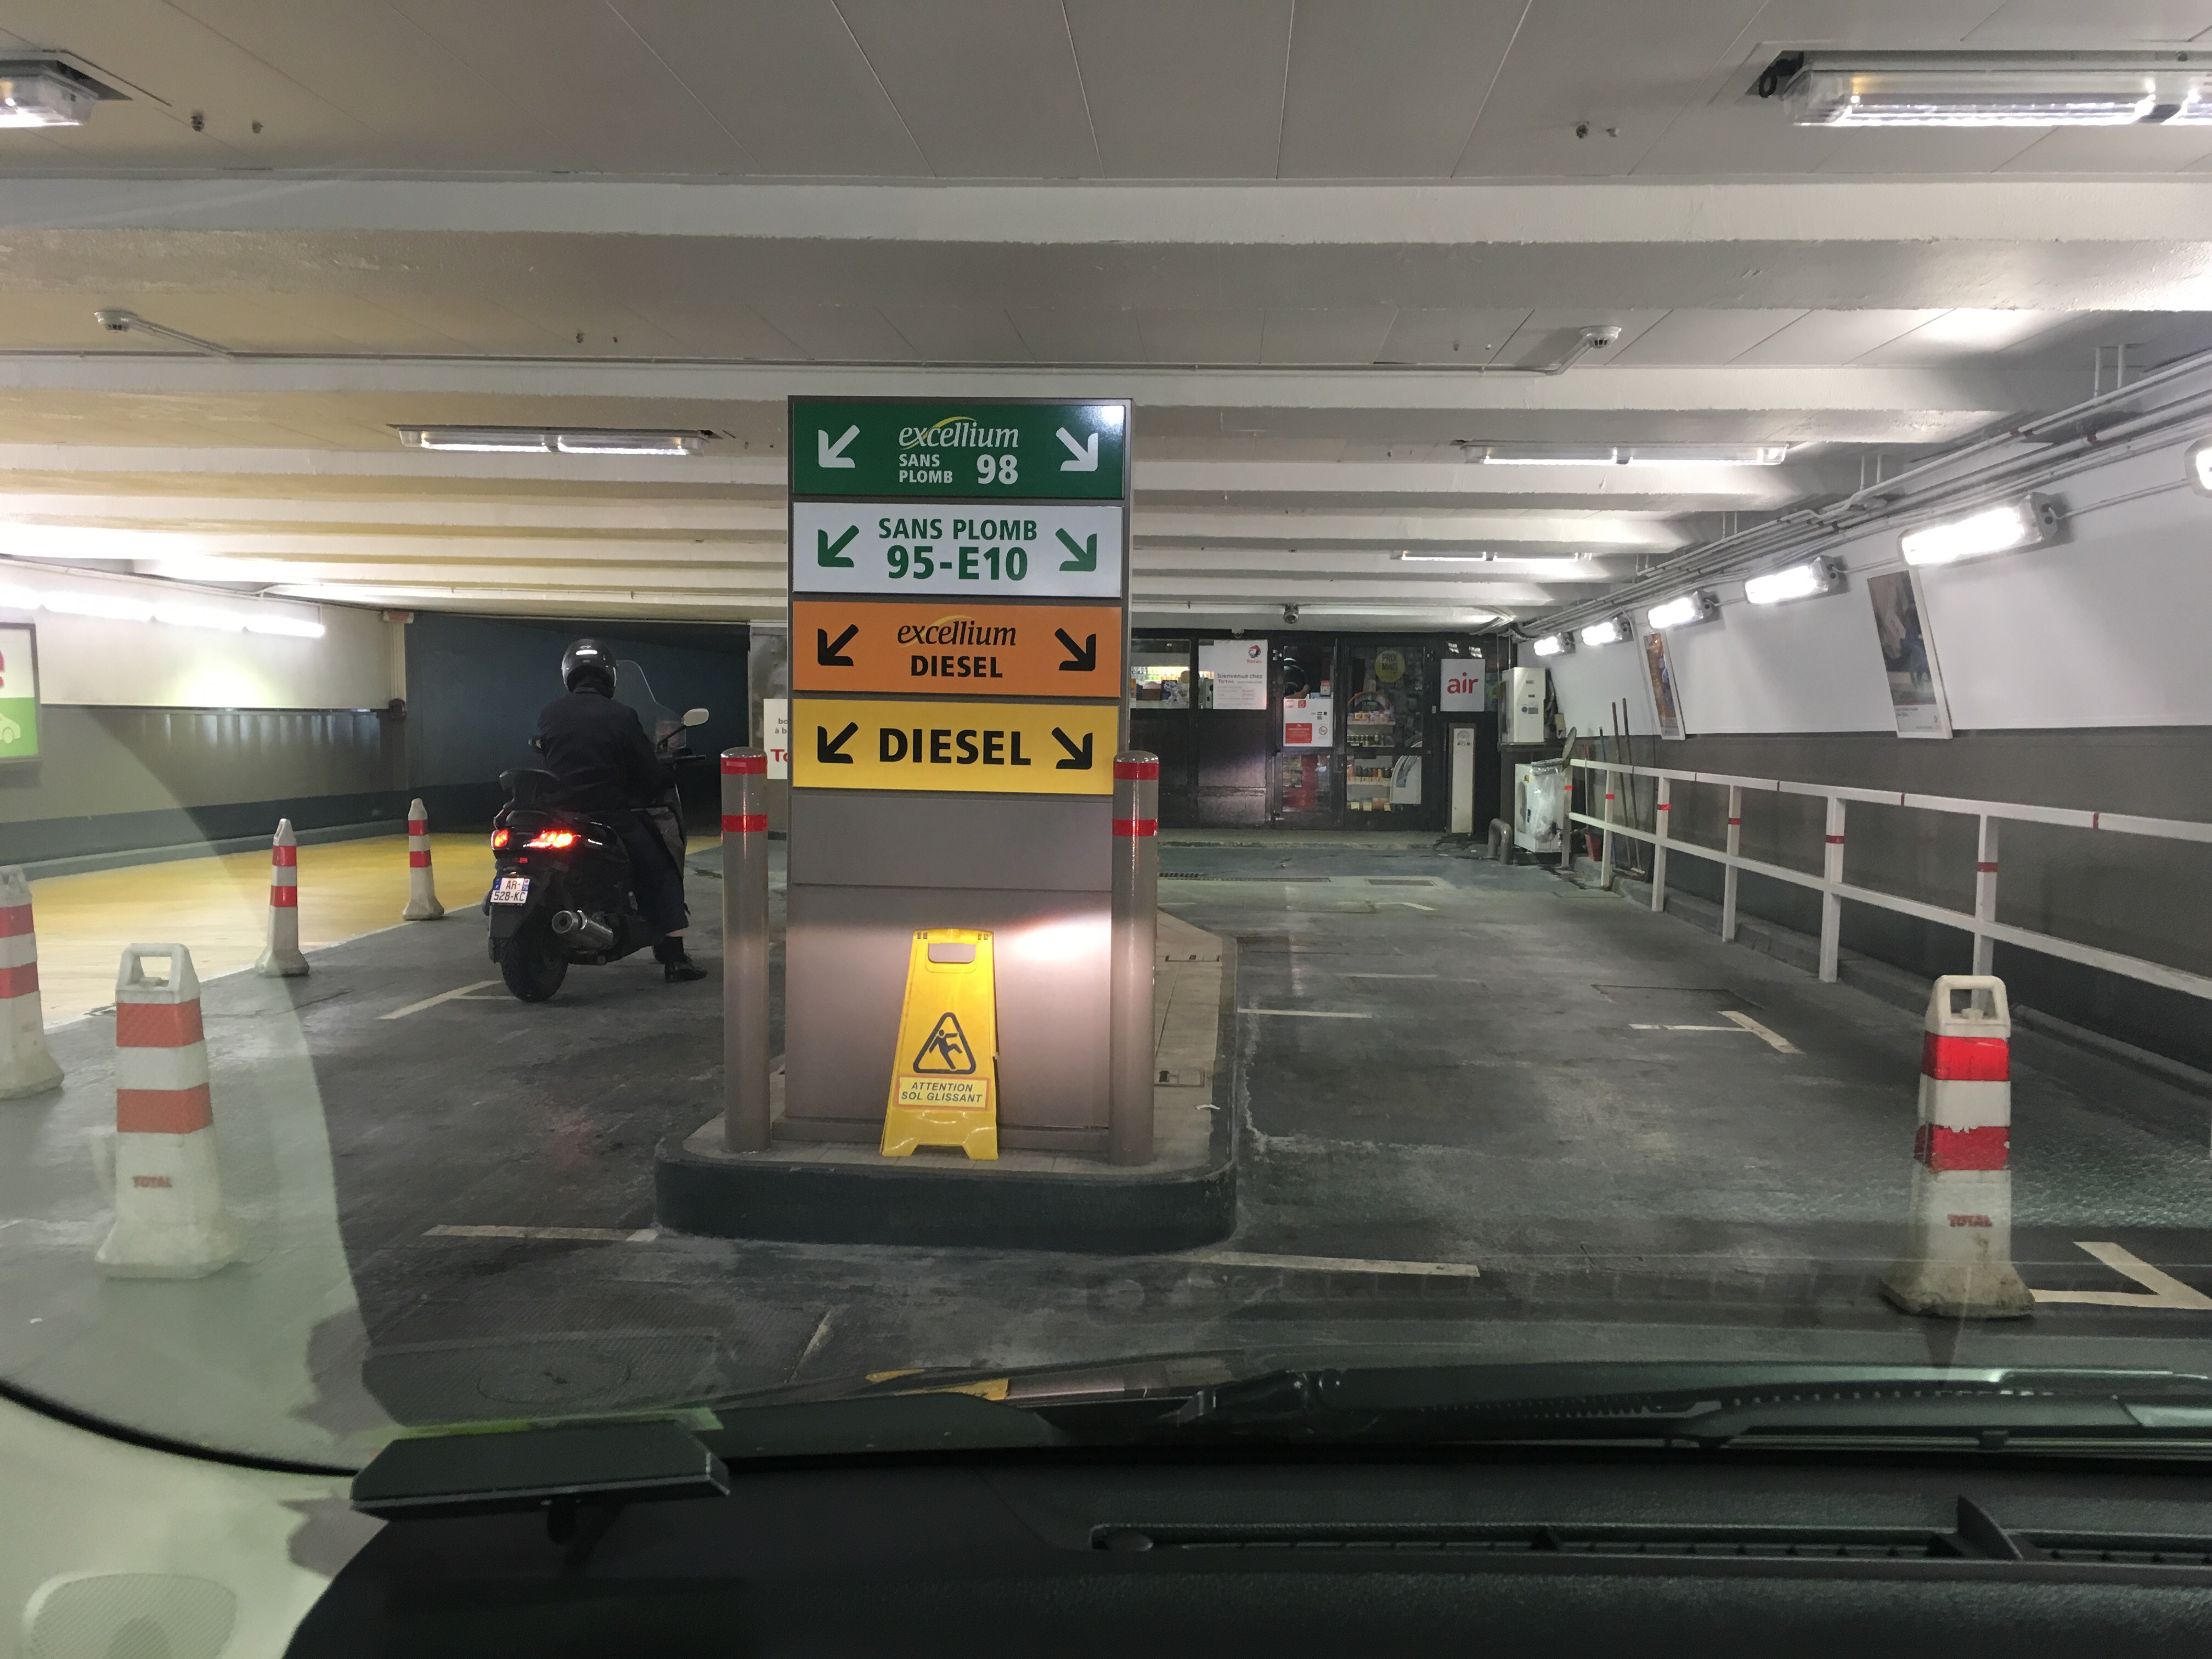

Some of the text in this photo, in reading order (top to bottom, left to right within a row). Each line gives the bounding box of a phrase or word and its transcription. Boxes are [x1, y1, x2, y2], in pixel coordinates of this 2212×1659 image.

[899, 417, 1018, 448] excellium
[899, 453, 940, 467] SANS
[977, 454, 1019, 484] 98
[899, 470, 953, 484] PLOMB
[878, 517, 1037, 541] SANS PLOMB
[887, 545, 1028, 581] 95-E10
[897, 619, 1017, 647] excellium
[911, 654, 1003, 679] DIESEL
[1447, 672, 1479, 694] air
[879, 727, 1031, 766] DIESEL
[494, 891, 525, 901] 528-KC
[901, 1091, 983, 1103] SOL GLISSANT
[911, 1081, 973, 1092] ATTENTION
[1947, 1214, 1993, 1227] TOTAL
